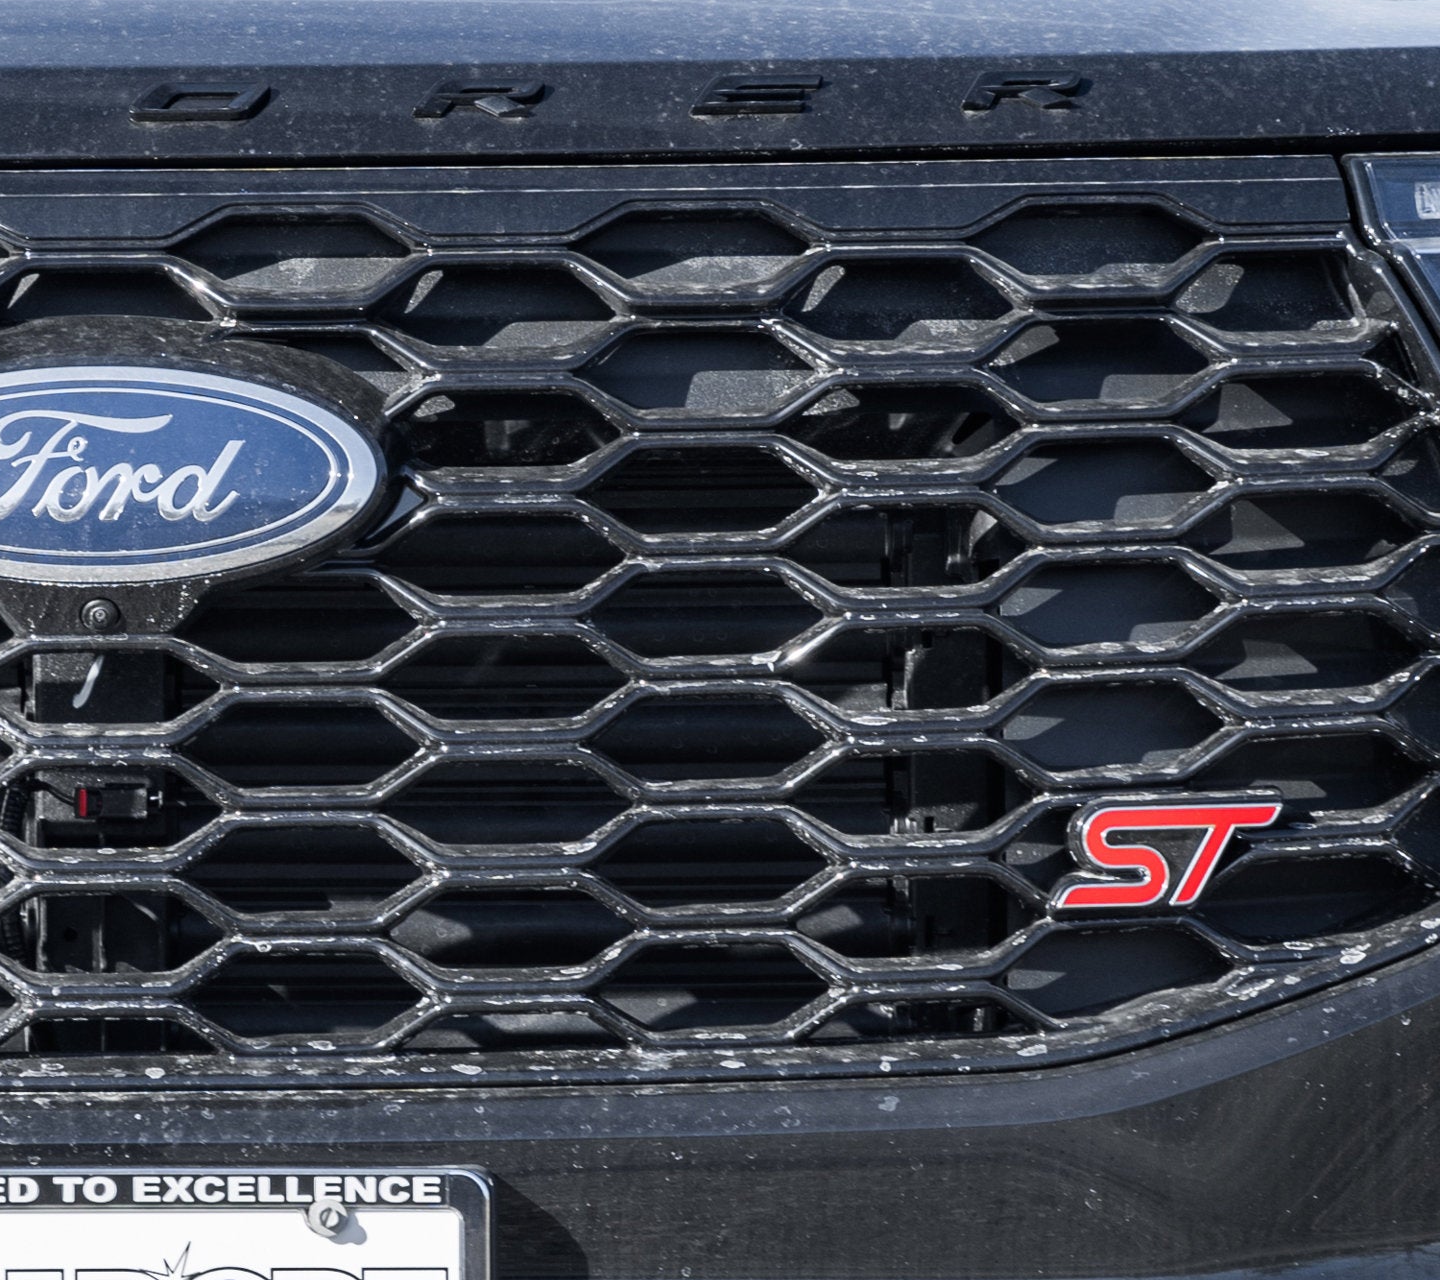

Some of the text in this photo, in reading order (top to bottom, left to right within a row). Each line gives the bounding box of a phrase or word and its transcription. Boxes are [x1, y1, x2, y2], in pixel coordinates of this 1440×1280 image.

[1055, 802, 1284, 908] ST
[52, 1176, 118, 1204] TO
[131, 1175, 442, 1204] EXCELLENCE
